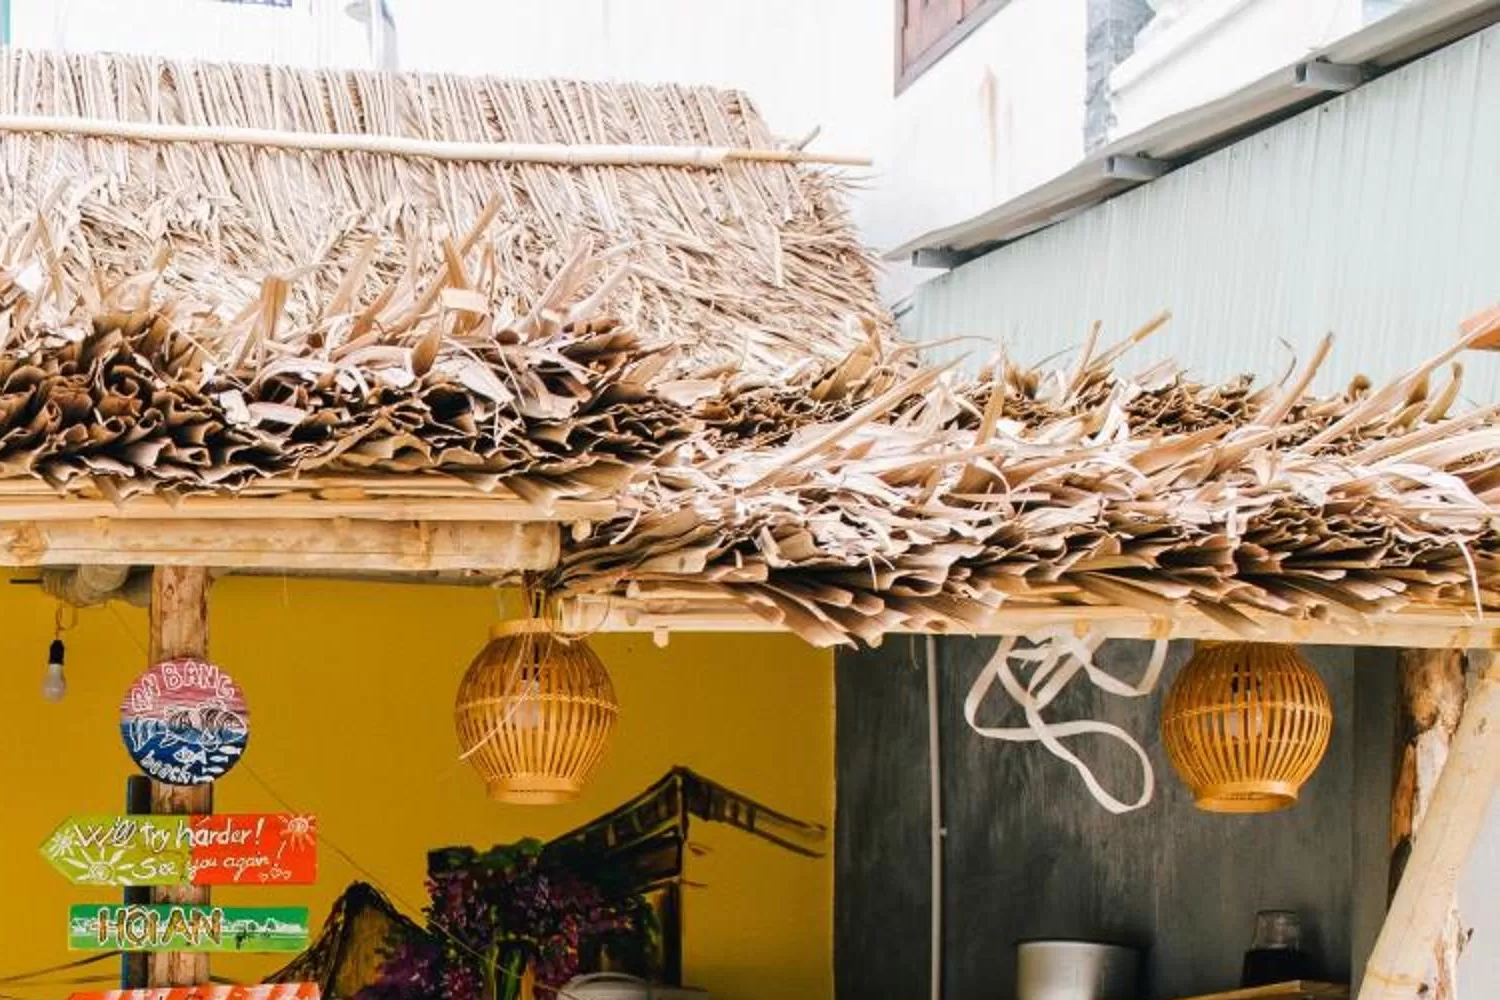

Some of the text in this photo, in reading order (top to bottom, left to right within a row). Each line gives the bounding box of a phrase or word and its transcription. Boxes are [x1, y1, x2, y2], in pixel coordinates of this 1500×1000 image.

[162, 660, 235, 699] BANG
[176, 817, 266, 849] harder!
[186, 855, 218, 881] you
